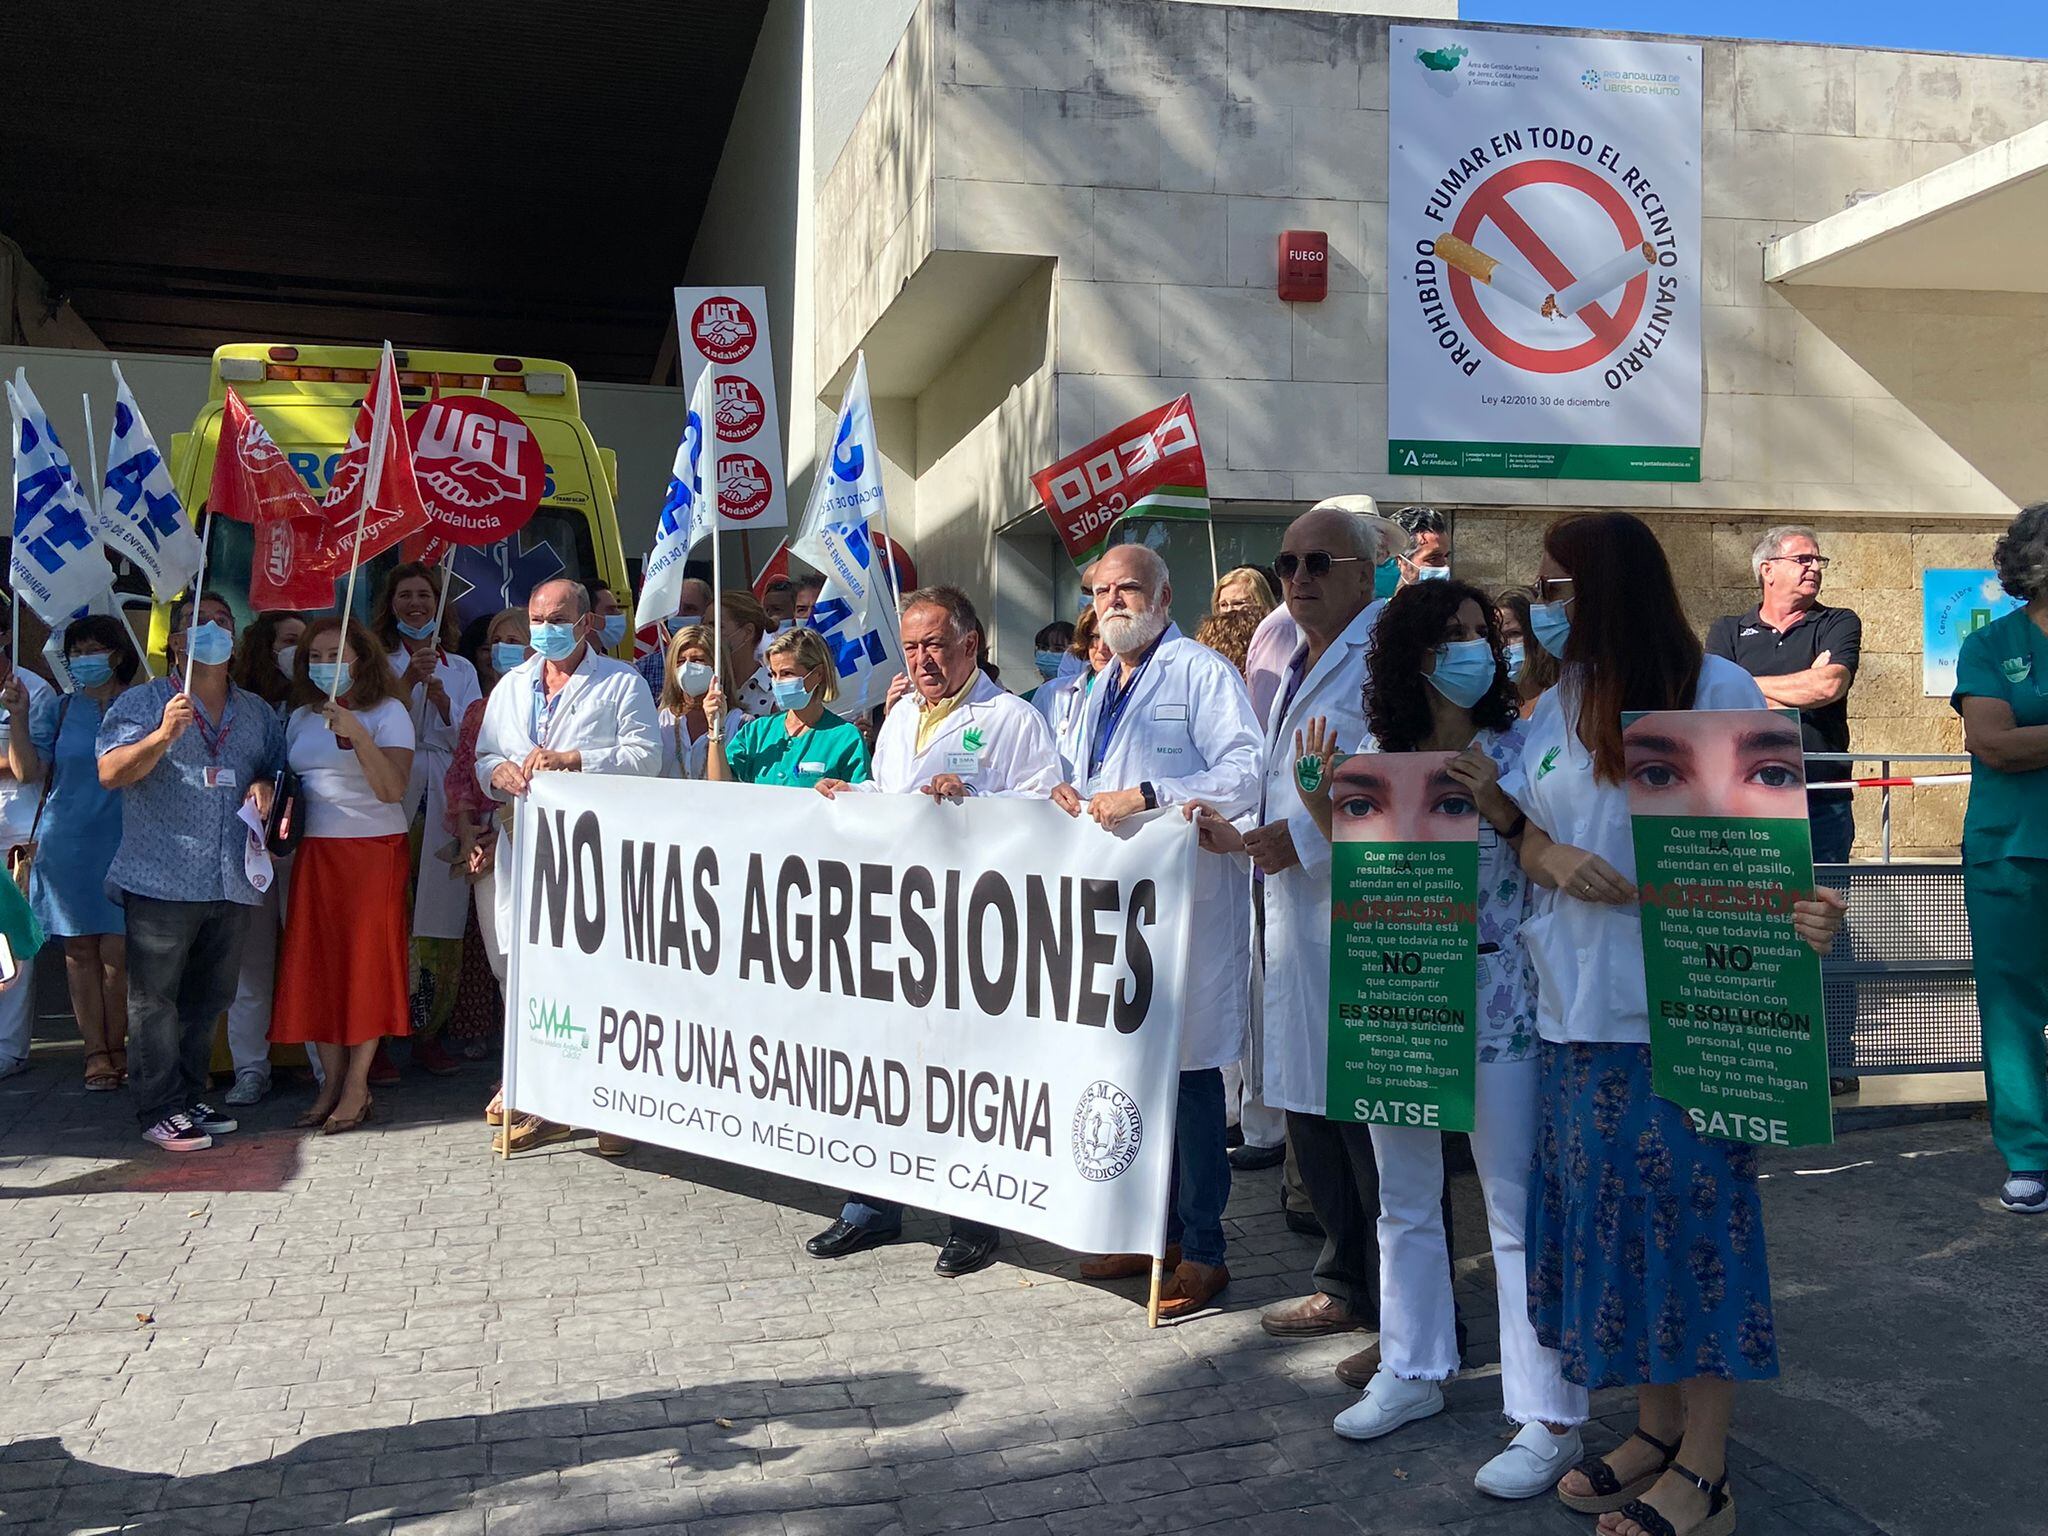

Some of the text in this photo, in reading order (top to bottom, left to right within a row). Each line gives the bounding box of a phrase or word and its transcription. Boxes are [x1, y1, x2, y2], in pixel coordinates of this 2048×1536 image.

[1290, 250, 1323, 261] FUEGO
[1415, 127, 1678, 390] PROHIBIDO FUMAR EN TODO EL RECINTO SANITARIO
[703, 304, 740, 322] UGT
[1481, 395, 1610, 407] Ley 42/2010 30 de diciembre
[418, 405, 527, 478] UGT
[719, 460, 756, 480] UGT
[425, 500, 500, 528] Andalucía
[824, 538, 834, 550] DE
[1938, 605, 1951, 635] Centro
[1671, 827, 1770, 841] Que me den los
[1708, 838, 1730, 851] LA
[1761, 848, 1780, 858] me
[1364, 851, 1385, 861] Que
[1430, 852, 1445, 860] los
[1657, 859, 1794, 876] atiendan en el pasillo,
[1350, 880, 1393, 888] atiendan
[1413, 880, 1421, 888] el
[1425, 880, 1463, 890] pasillo,
[1674, 876, 1743, 887] que aún no
[1362, 894, 1381, 903] que
[528, 806, 1155, 1034] NO MAS AGRESIONES
[1667, 907, 1793, 924] que la consulta está
[1354, 920, 1458, 932] que la consulta está
[1660, 921, 1692, 935] llena,
[1696, 926, 1719, 936] que
[1723, 925, 1770, 939] todavía
[1774, 931, 1790, 940] no
[1347, 934, 1373, 944] llena,
[1377, 936, 1395, 945] que
[1399, 936, 1438, 945] todavía
[1458, 938, 1468, 946] te
[1664, 938, 1702, 950] toque,
[1753, 944, 1801, 957] puedan
[1348, 949, 1379, 958] toque,
[1423, 951, 1462, 960] puedan
[1382, 952, 1422, 975] NO
[1705, 944, 1752, 972] NO
[1366, 978, 1440, 989] que compartir
[1689, 972, 1776, 988] que compartir
[1358, 990, 1366, 999] la
[1370, 990, 1424, 1001] habitación
[1680, 986, 1788, 1006] la habitación con
[529, 997, 586, 1040] SMA
[1339, 1004, 1361, 1019] ES
[1368, 1004, 1464, 1025] SOLUCIÓN
[1345, 1018, 1363, 1027] que
[1661, 1001, 1687, 1018] ES
[1694, 1004, 1810, 1033] SOLUCIÓN
[1668, 1017, 1690, 1027] que
[1694, 1020, 1709, 1029] no
[1747, 1025, 1810, 1041] suficiente
[1359, 1033, 1448, 1046] personal, que no
[1687, 1035, 1792, 1055] personal, que no
[1371, 1047, 1434, 1060] tenga cama,
[1702, 1050, 1778, 1071] tenga cama,
[1345, 1061, 1363, 1071] que
[1367, 1060, 1386, 1071] hoy
[1406, 1065, 1422, 1073] me
[1426, 1064, 1458, 1078] hagan
[1673, 1064, 1808, 1090] que hoy no me hagan
[597, 1005, 1052, 1157] POR UNA SANIDAD DIGNA
[1367, 1075, 1382, 1084] las
[1701, 1082, 1718, 1093] las
[1354, 1098, 1439, 1127] SATSE
[1688, 1107, 1789, 1145] SATSE
[592, 1086, 1048, 1211] SINDICATO MÉDICO DE CÁDIZ
[1081, 1103, 1140, 1179] MEDICO DE CADIZ
